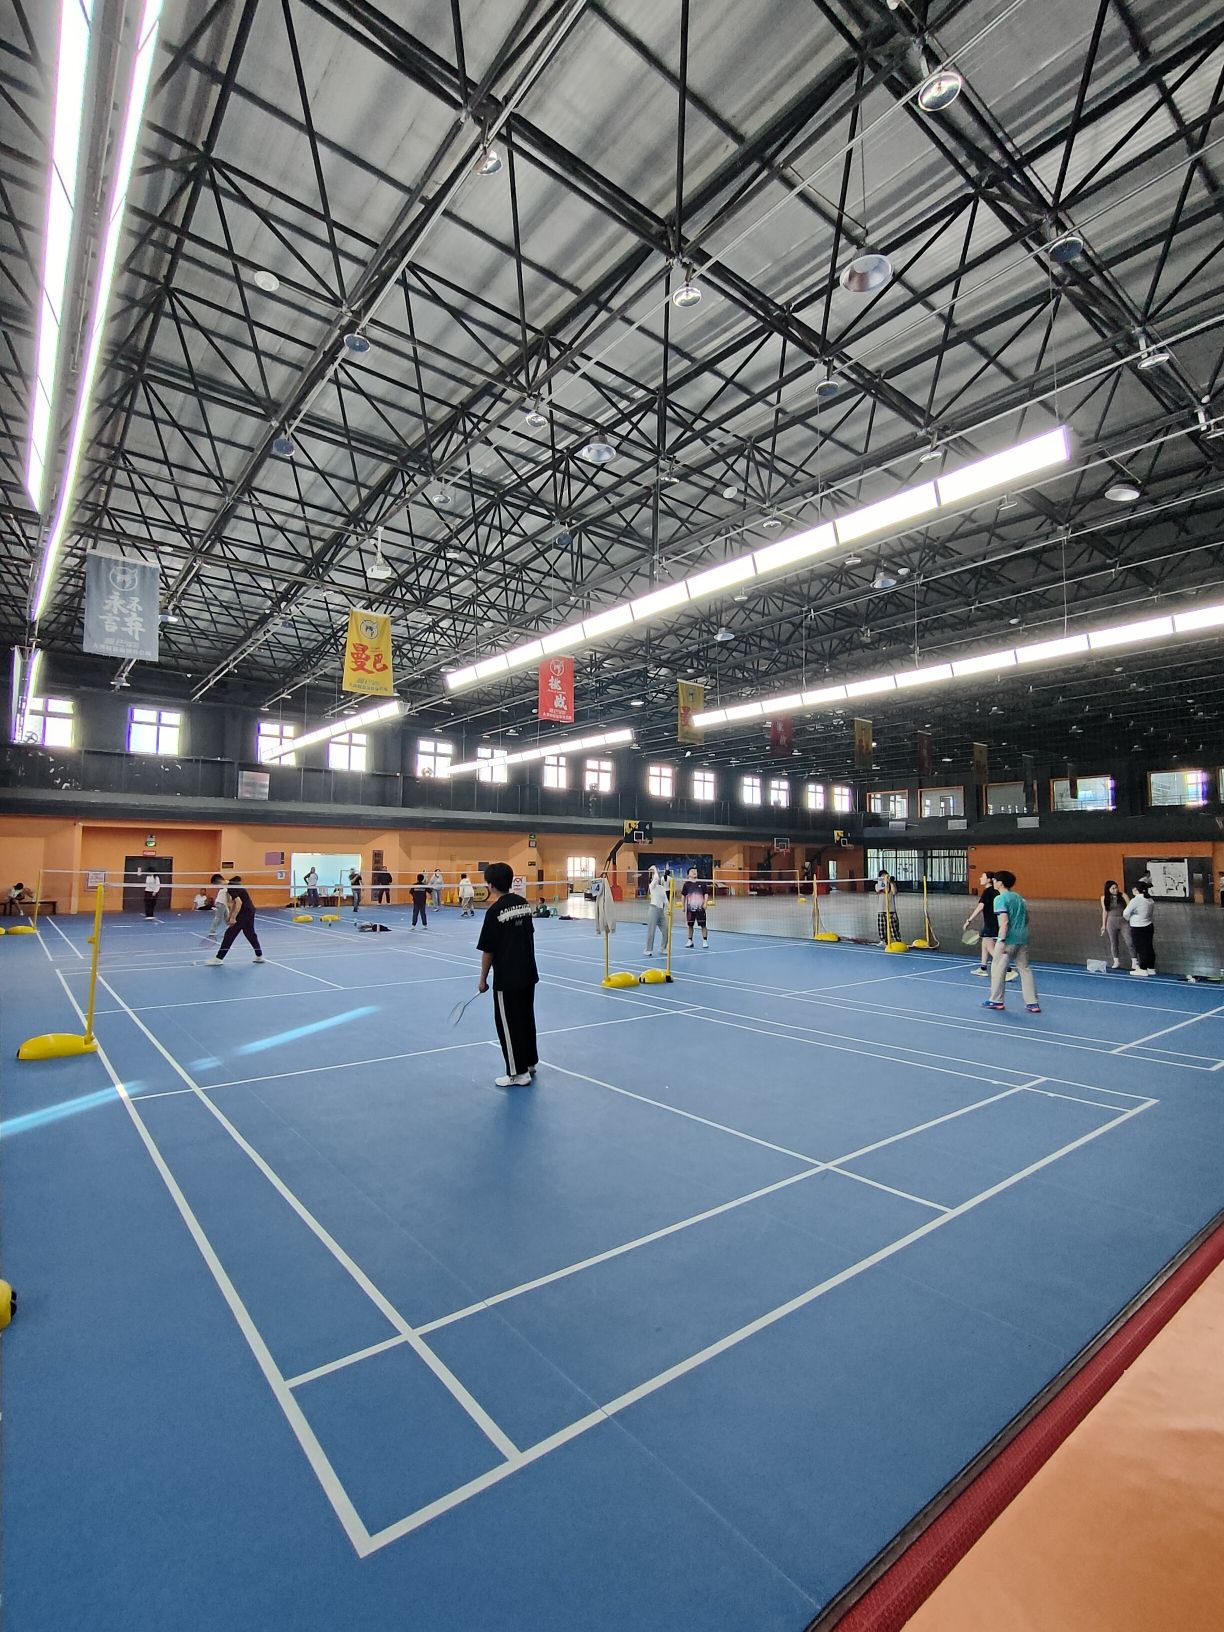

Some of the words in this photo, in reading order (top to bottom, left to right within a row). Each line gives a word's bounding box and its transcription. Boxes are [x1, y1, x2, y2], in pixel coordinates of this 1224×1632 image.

[103, 591, 143, 614] 永不
[99, 612, 146, 640] 言弃
[350, 642, 388, 674] 曼巴
